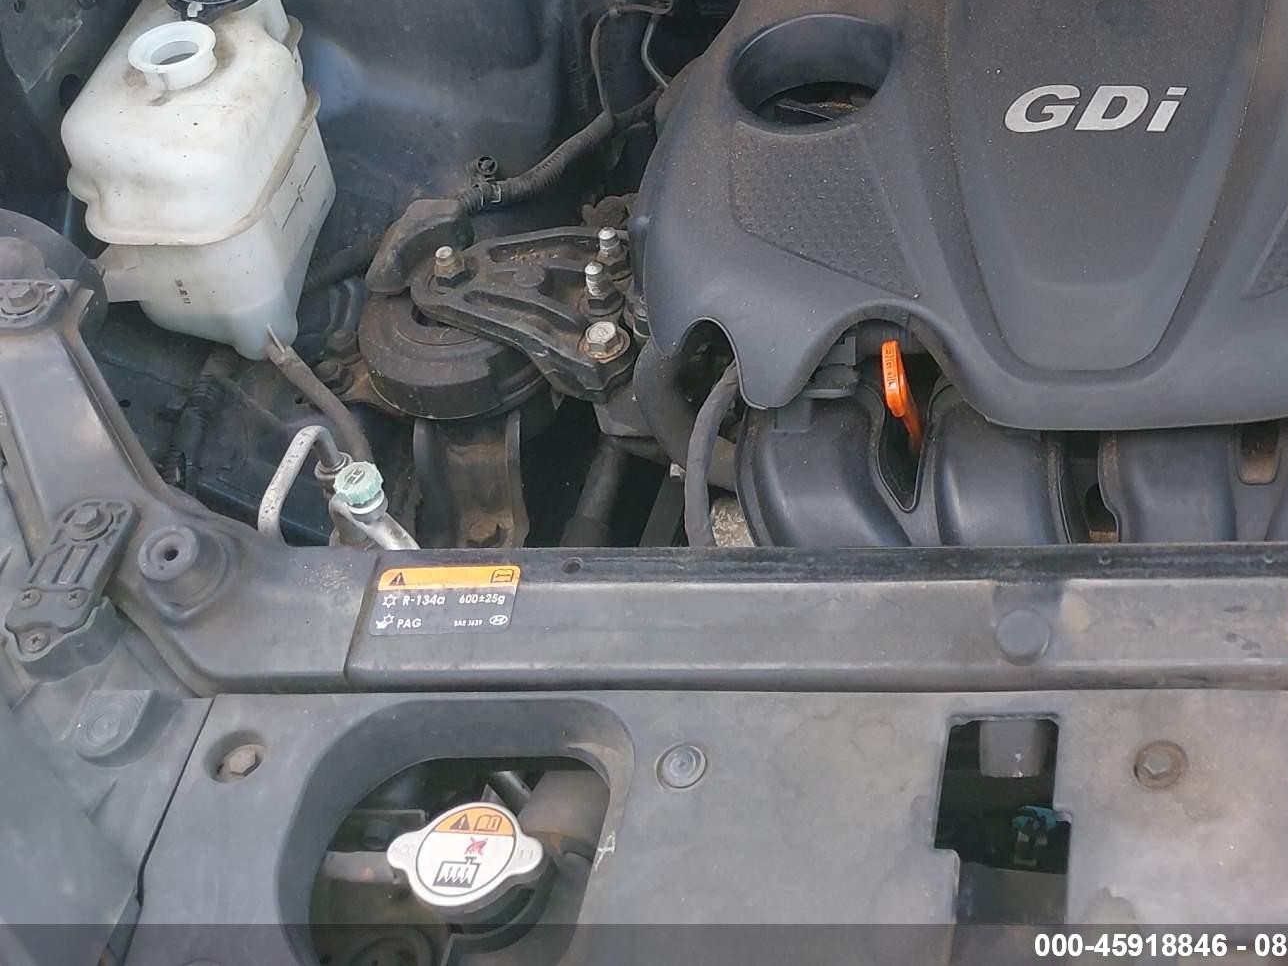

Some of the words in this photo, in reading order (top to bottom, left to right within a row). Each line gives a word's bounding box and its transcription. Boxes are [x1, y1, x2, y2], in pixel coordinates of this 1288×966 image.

[1003, 84, 1189, 133] GDi
[402, 594, 446, 606] R-134a
[458, 593, 506, 605] 600±25g
[396, 617, 423, 629] PAG
